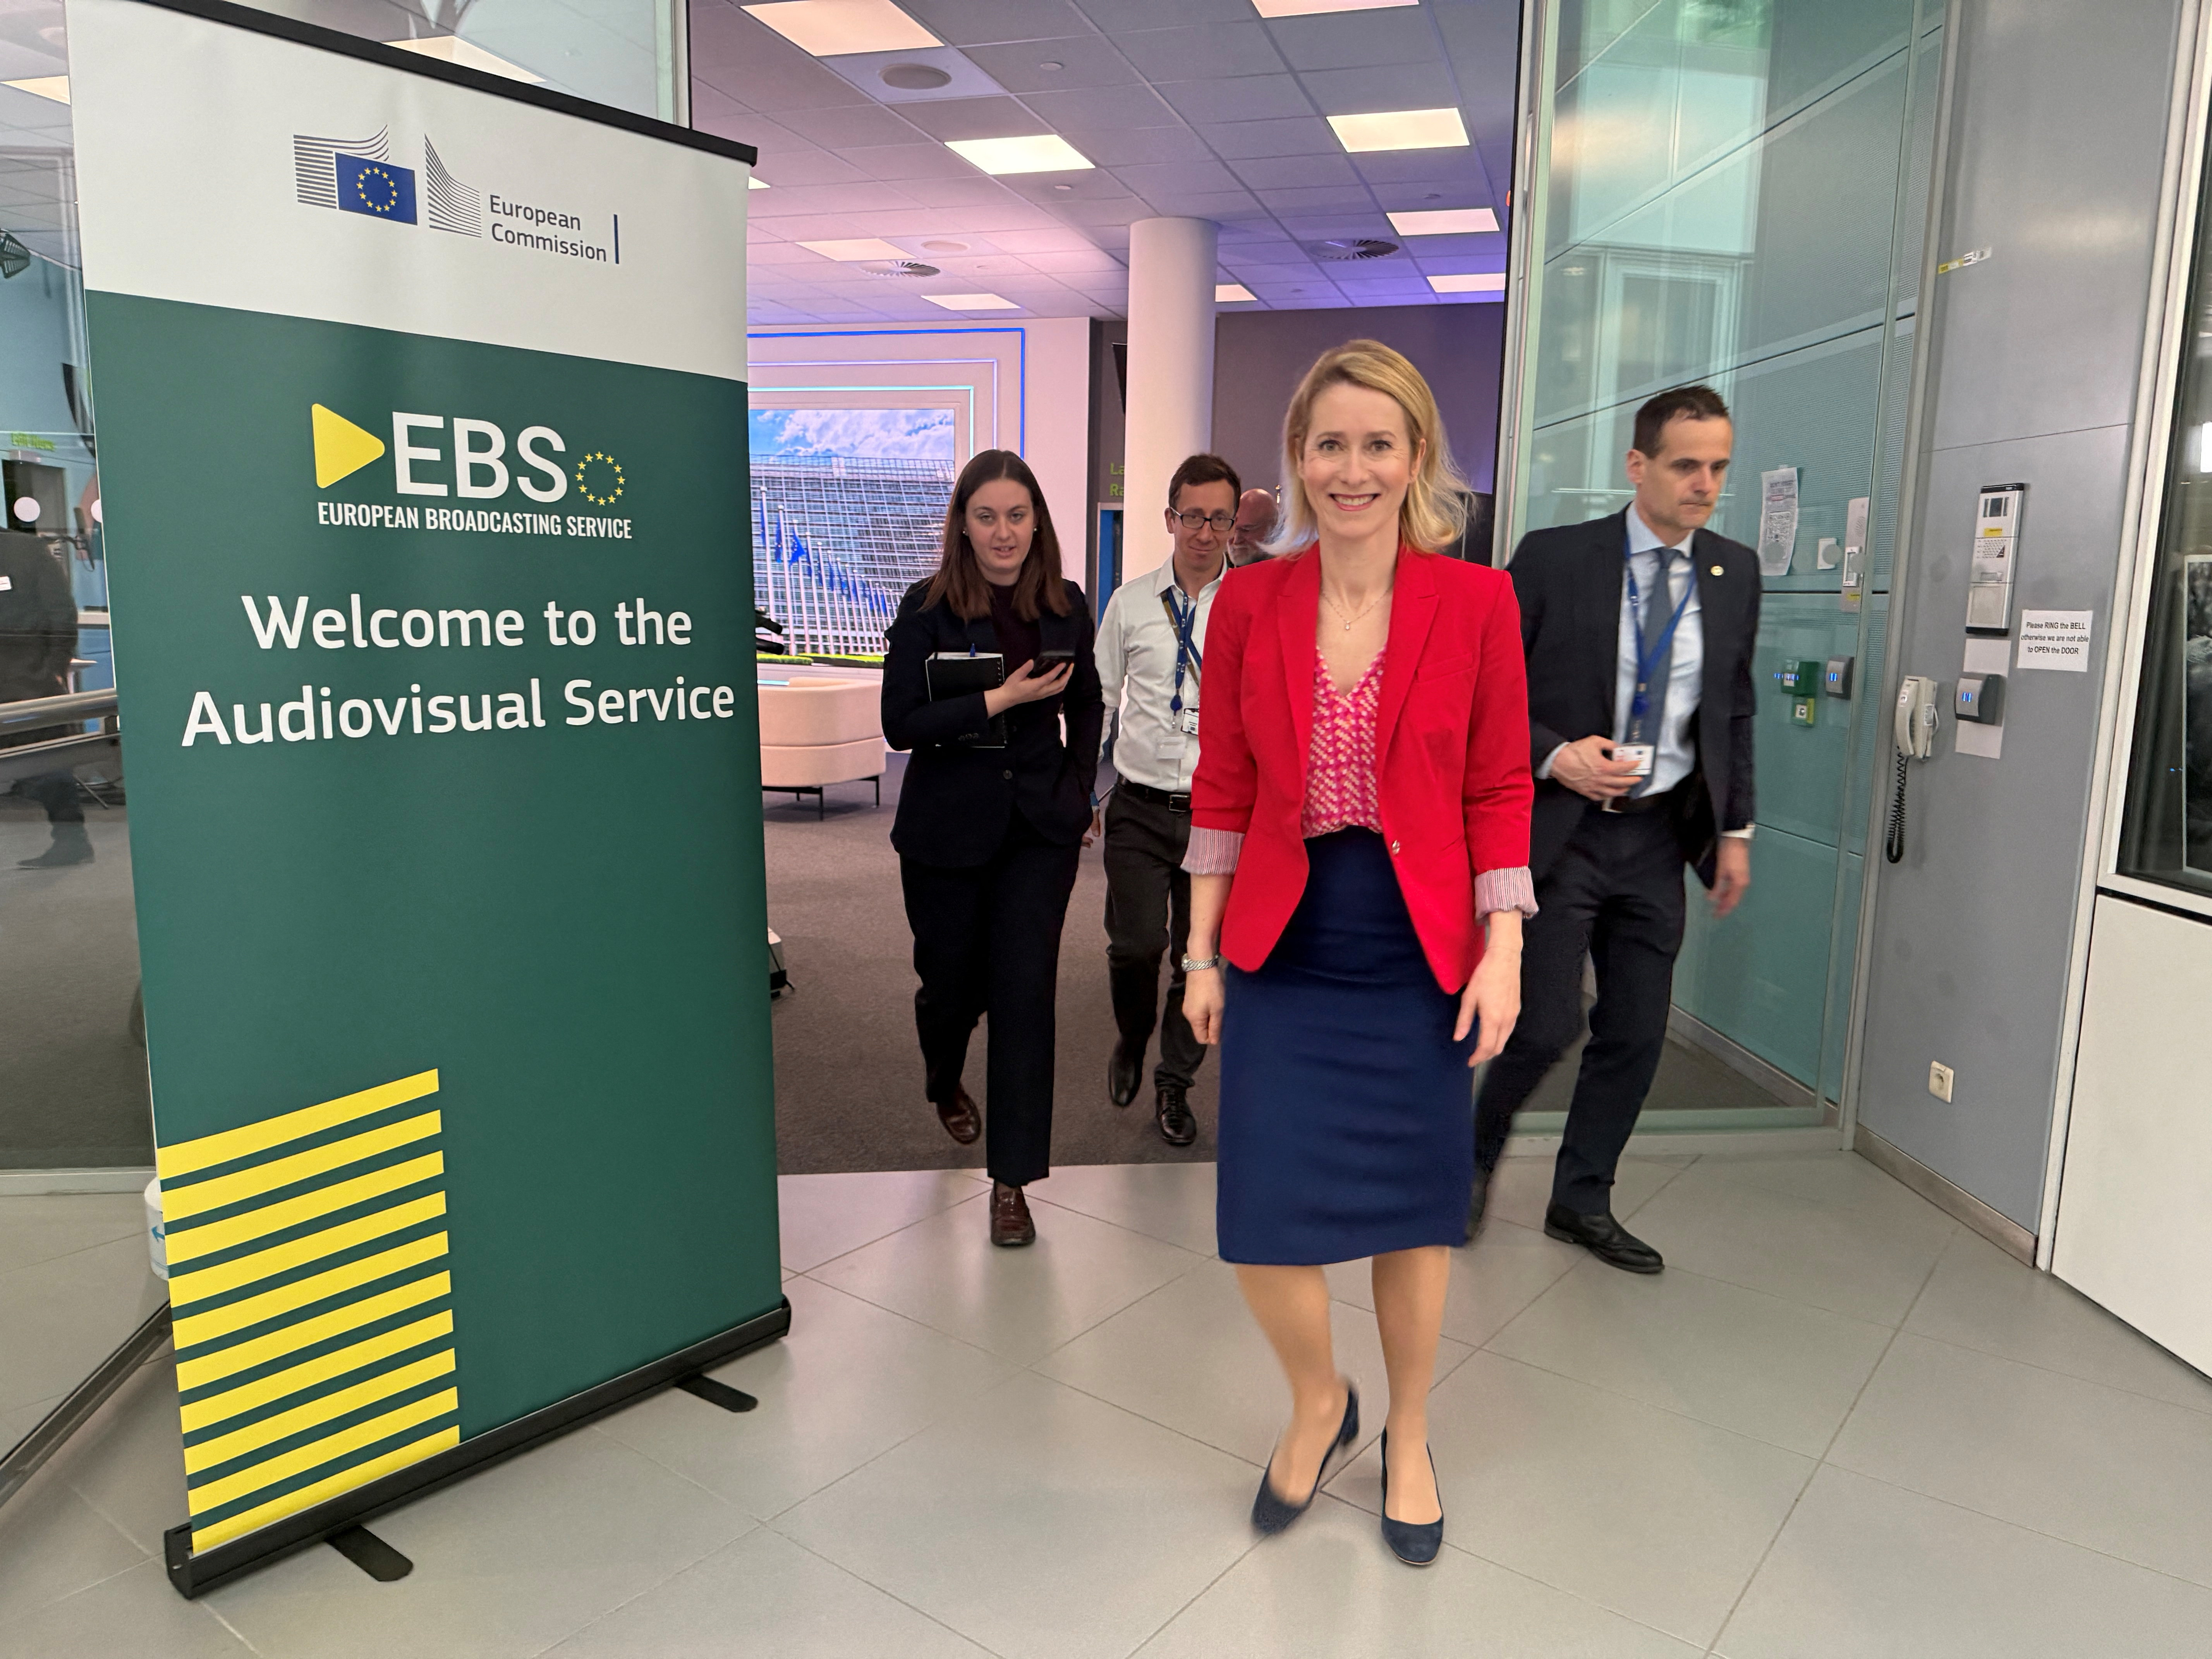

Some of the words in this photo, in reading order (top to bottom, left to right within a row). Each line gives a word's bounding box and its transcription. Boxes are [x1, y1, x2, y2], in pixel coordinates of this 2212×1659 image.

[489, 194, 581, 231] European
[491, 223, 607, 262] Commission
[392, 411, 568, 503] EBS
[317, 501, 419, 529] EUROPEAN
[425, 507, 562, 536] BROADCASTING
[566, 515, 632, 539] SERVICE
[240, 593, 525, 649] Welcome
[543, 601, 596, 646] to
[614, 597, 692, 646] the
[181, 678, 546, 747] Audiovisual
[564, 676, 735, 726] Service
